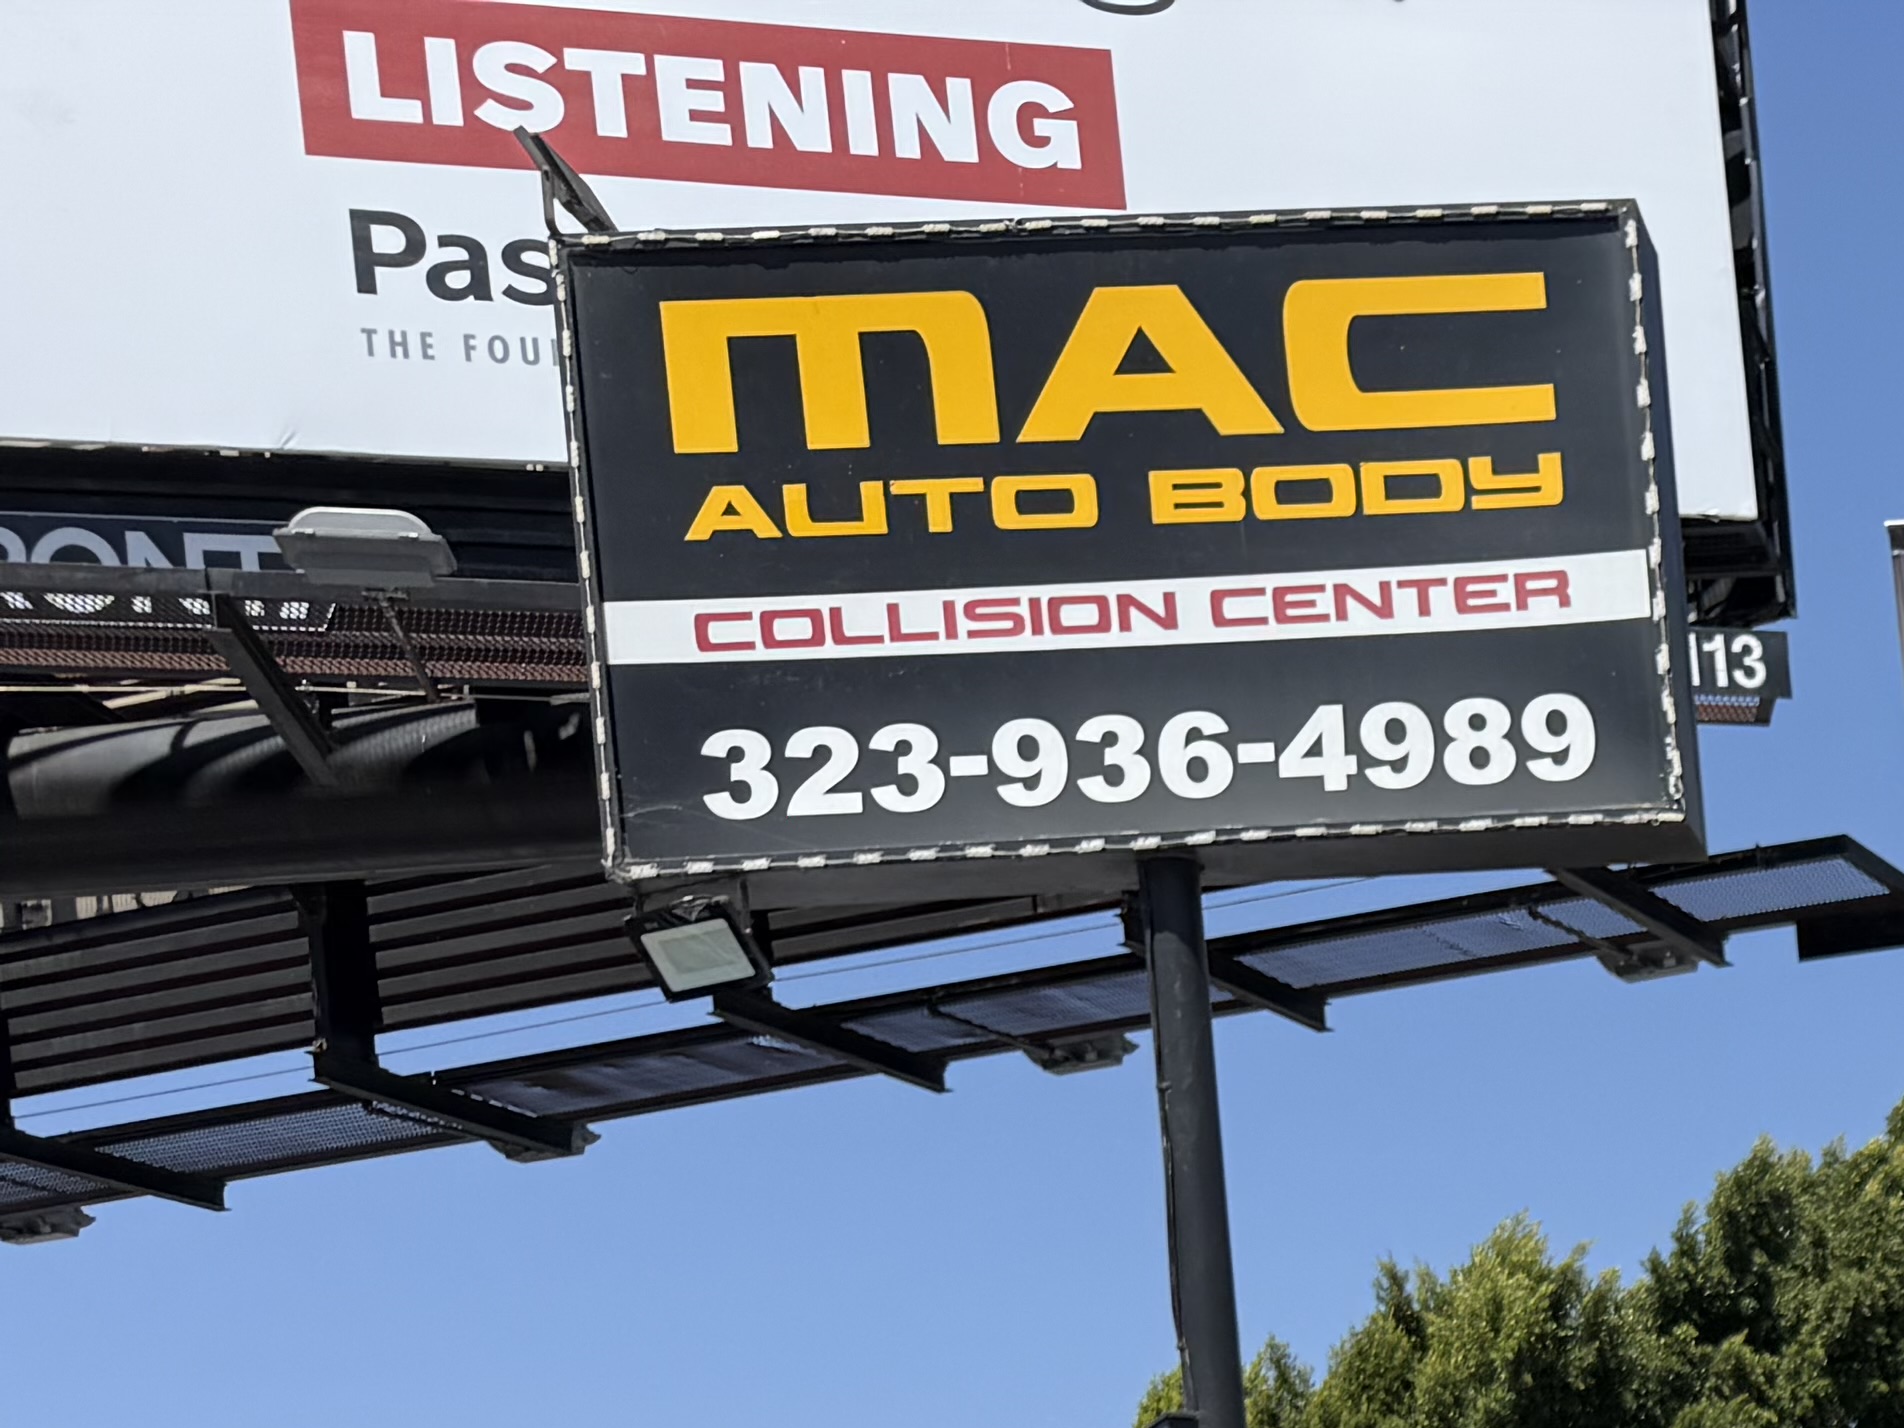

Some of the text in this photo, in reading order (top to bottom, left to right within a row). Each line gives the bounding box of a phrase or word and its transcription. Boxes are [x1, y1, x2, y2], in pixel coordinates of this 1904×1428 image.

[343, 30, 1083, 171] LISTENING
[360, 328, 436, 361] THE
[659, 272, 1556, 455] MAC
[684, 451, 1564, 542] AUTO BODY
[693, 570, 1572, 653] COLLISION CENTER
[701, 694, 1596, 819] 323-936-4989
